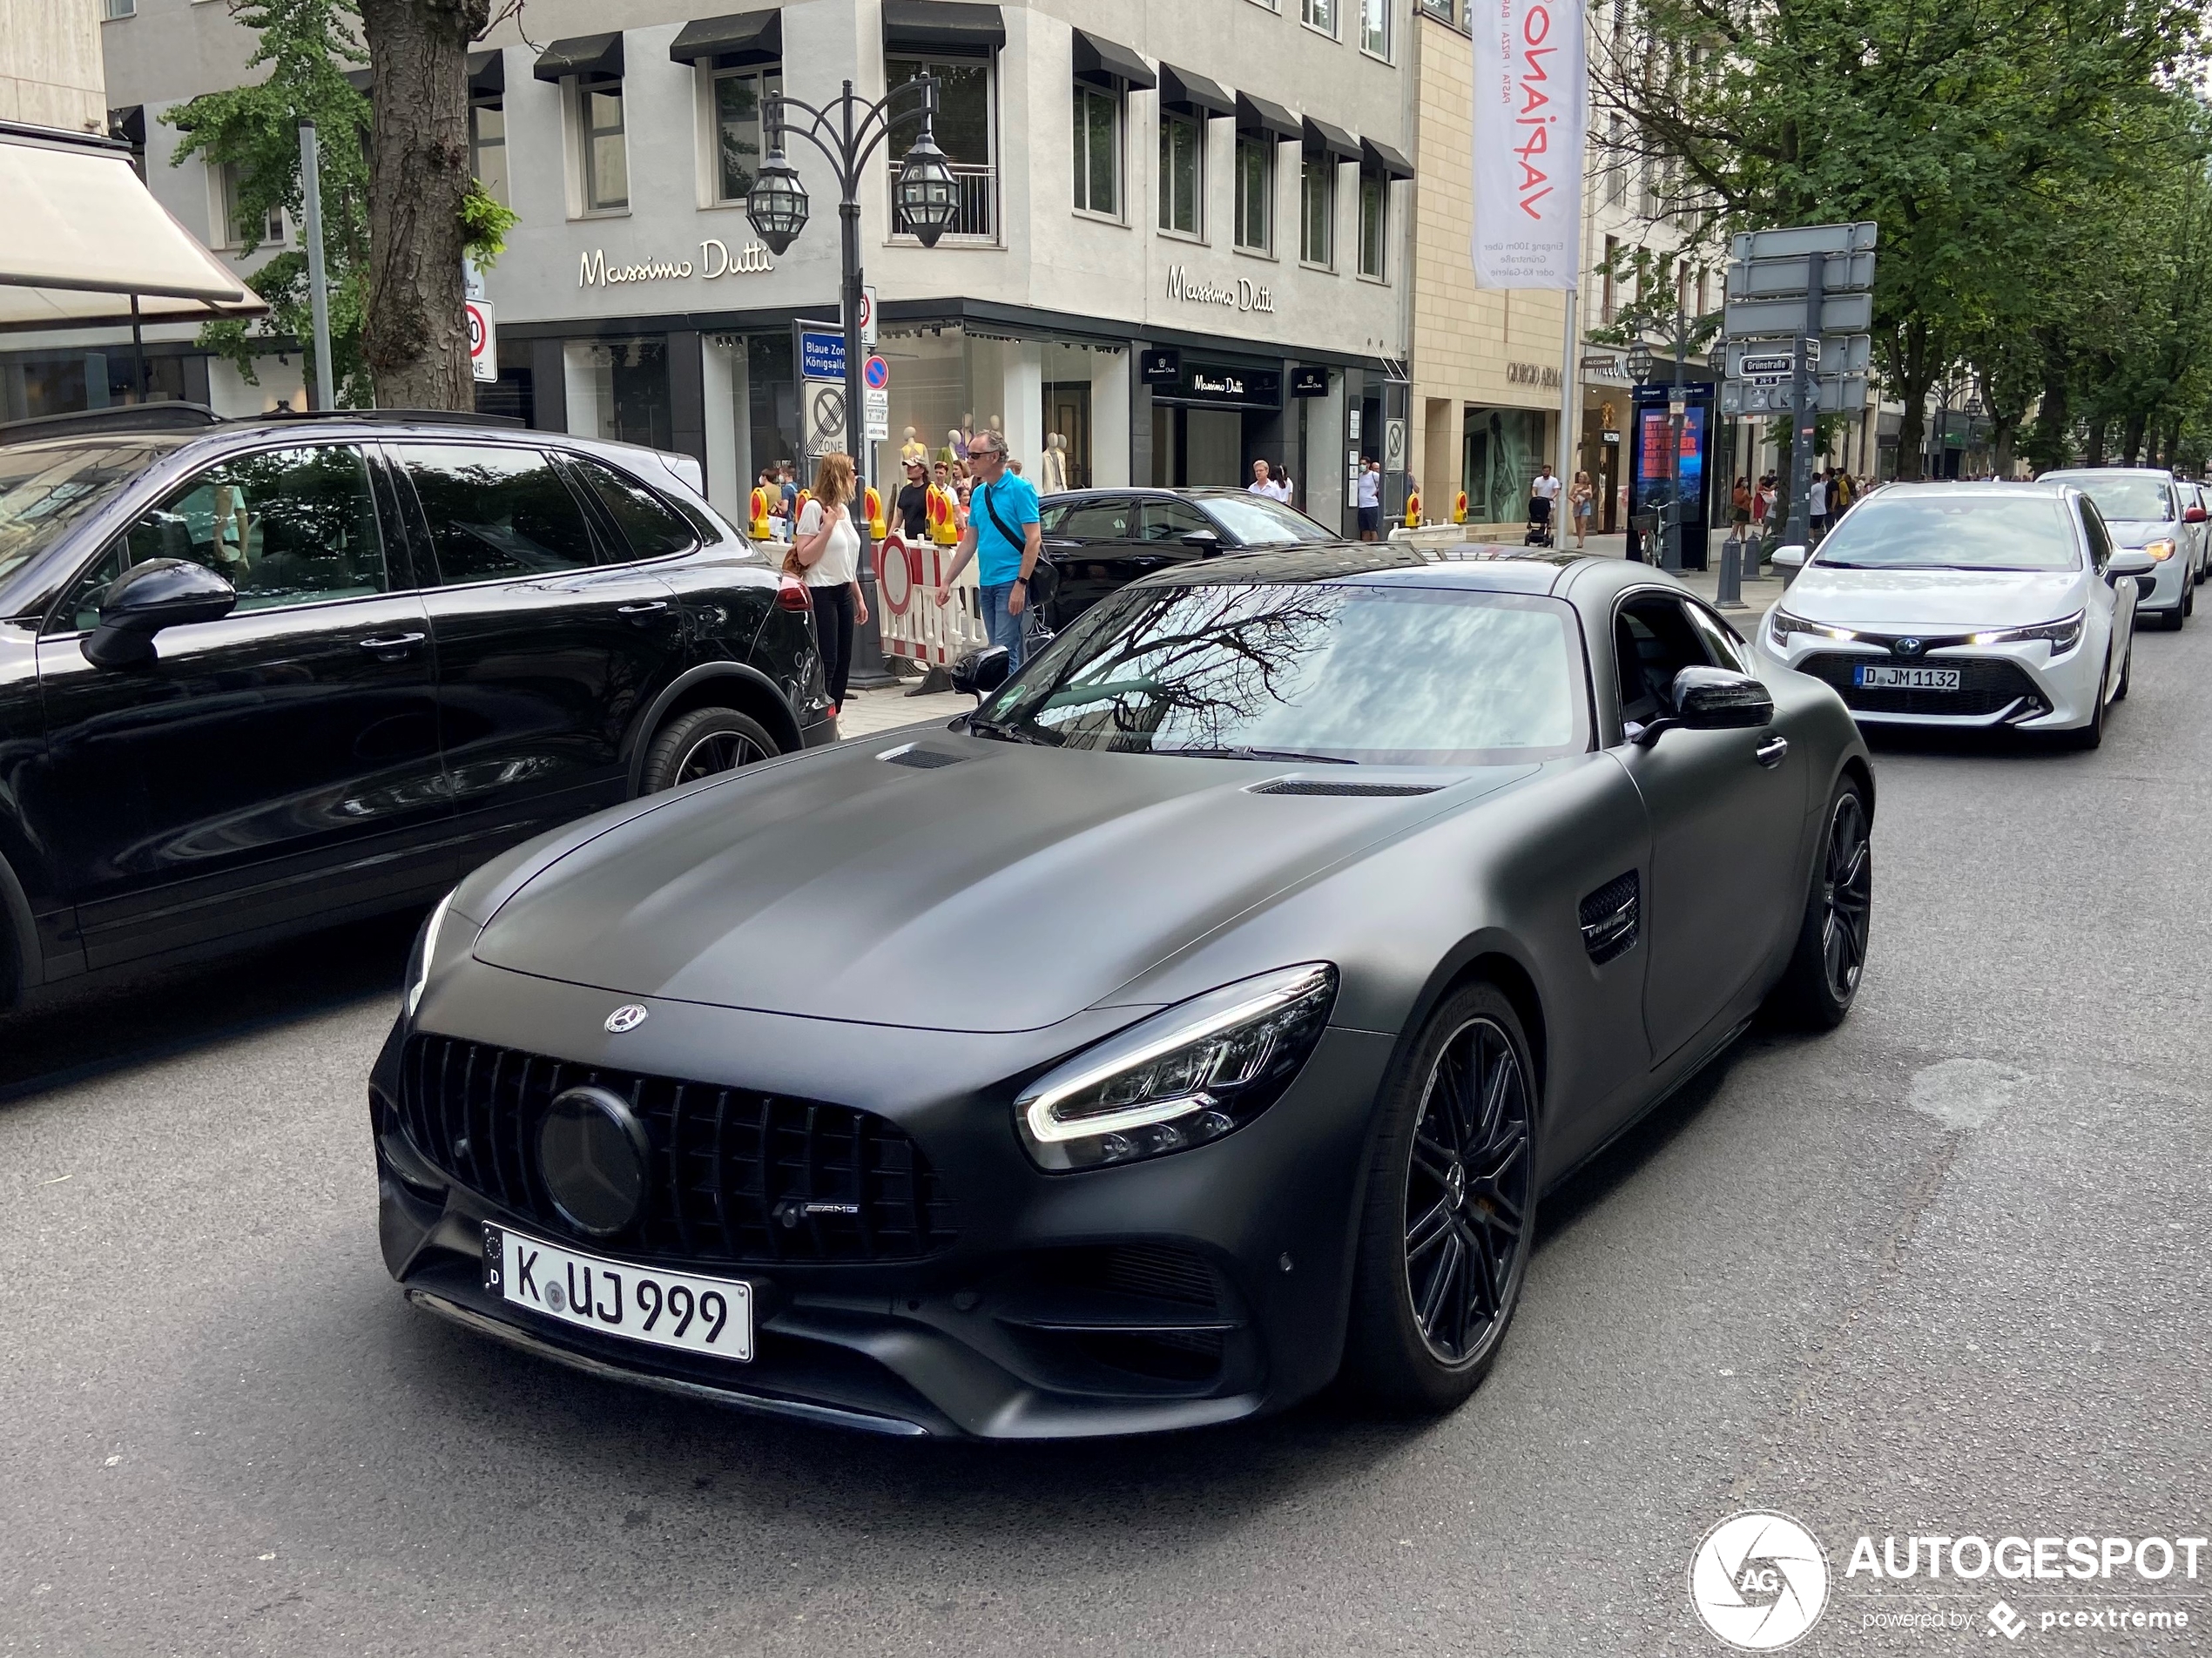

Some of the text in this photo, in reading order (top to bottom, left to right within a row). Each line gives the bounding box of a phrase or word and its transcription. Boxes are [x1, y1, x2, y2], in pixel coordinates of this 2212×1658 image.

[578, 239, 775, 288] Massimo Dutti
[1167, 264, 1276, 313] Massimo Dutti
[806, 341, 846, 356] Blaue Zon
[805, 354, 846, 371] Königsalle
[1747, 359, 1786, 371] Grünstraße
[1507, 361, 1563, 388] GIORGIO ARMA
[1194, 374, 1244, 394] Massimo Dutti
[818, 438, 844, 453] ZONE
[1865, 668, 1958, 688] D JM 1132
[821, 1204, 859, 1214] AMG
[489, 1268, 500, 1285] D
[517, 1245, 728, 1344] K UJ 999
